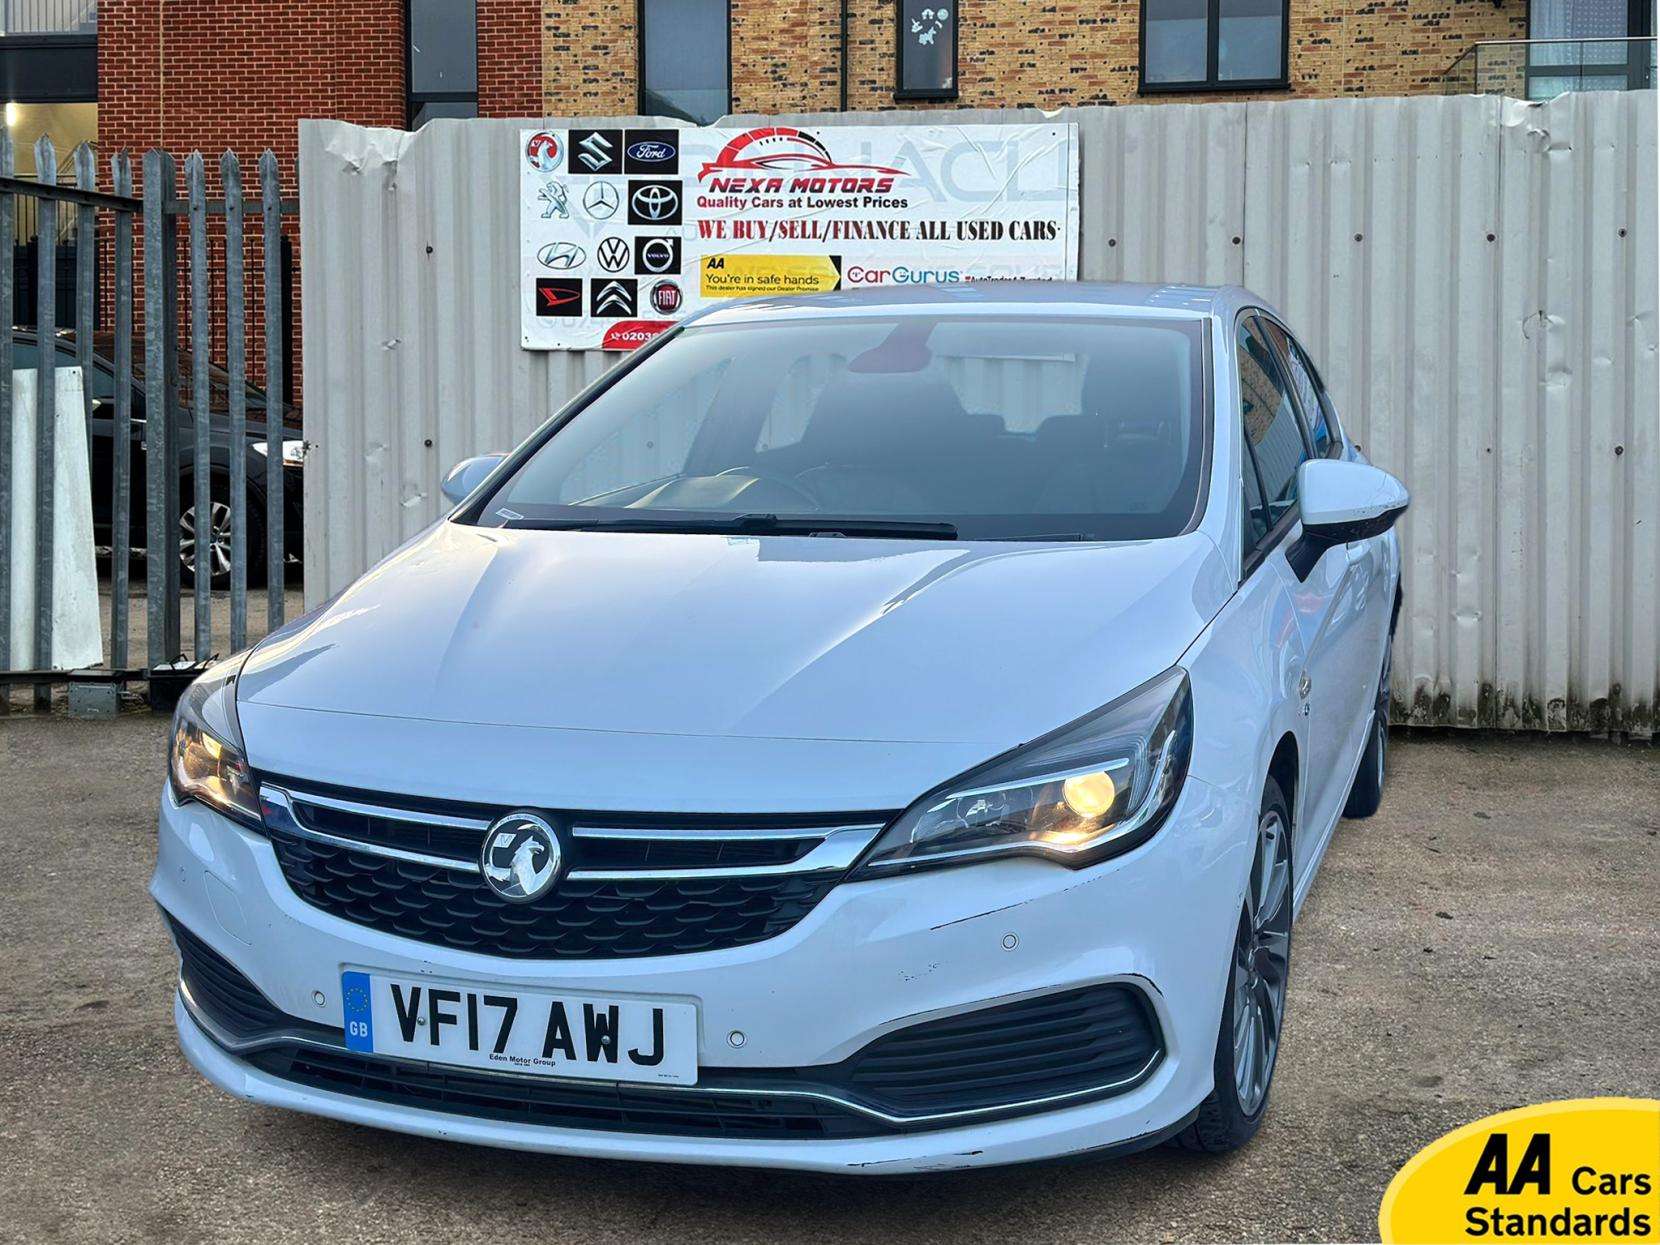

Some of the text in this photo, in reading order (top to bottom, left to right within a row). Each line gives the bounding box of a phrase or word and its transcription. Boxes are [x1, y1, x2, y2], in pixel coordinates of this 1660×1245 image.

[636, 144, 666, 159] Ford
[709, 177, 895, 194] NEXA MOTORS
[697, 196, 909, 210] Quality Cars at Lowest Prices
[697, 220, 727, 240] WE
[733, 220, 910, 242] BUY/SELL/FINANCE
[916, 220, 951, 240] ALL
[956, 220, 1004, 240] USED
[1008, 220, 1057, 240] CARS
[707, 257, 725, 269] AA
[706, 273, 820, 285] You're in safe hands
[847, 265, 960, 284] CarGurus
[658, 290, 676, 306] FIAT
[349, 1020, 369, 1038] GB
[390, 983, 664, 1066] VF17 AWJ
[489, 1053, 557, 1068] Eden Motor Group
